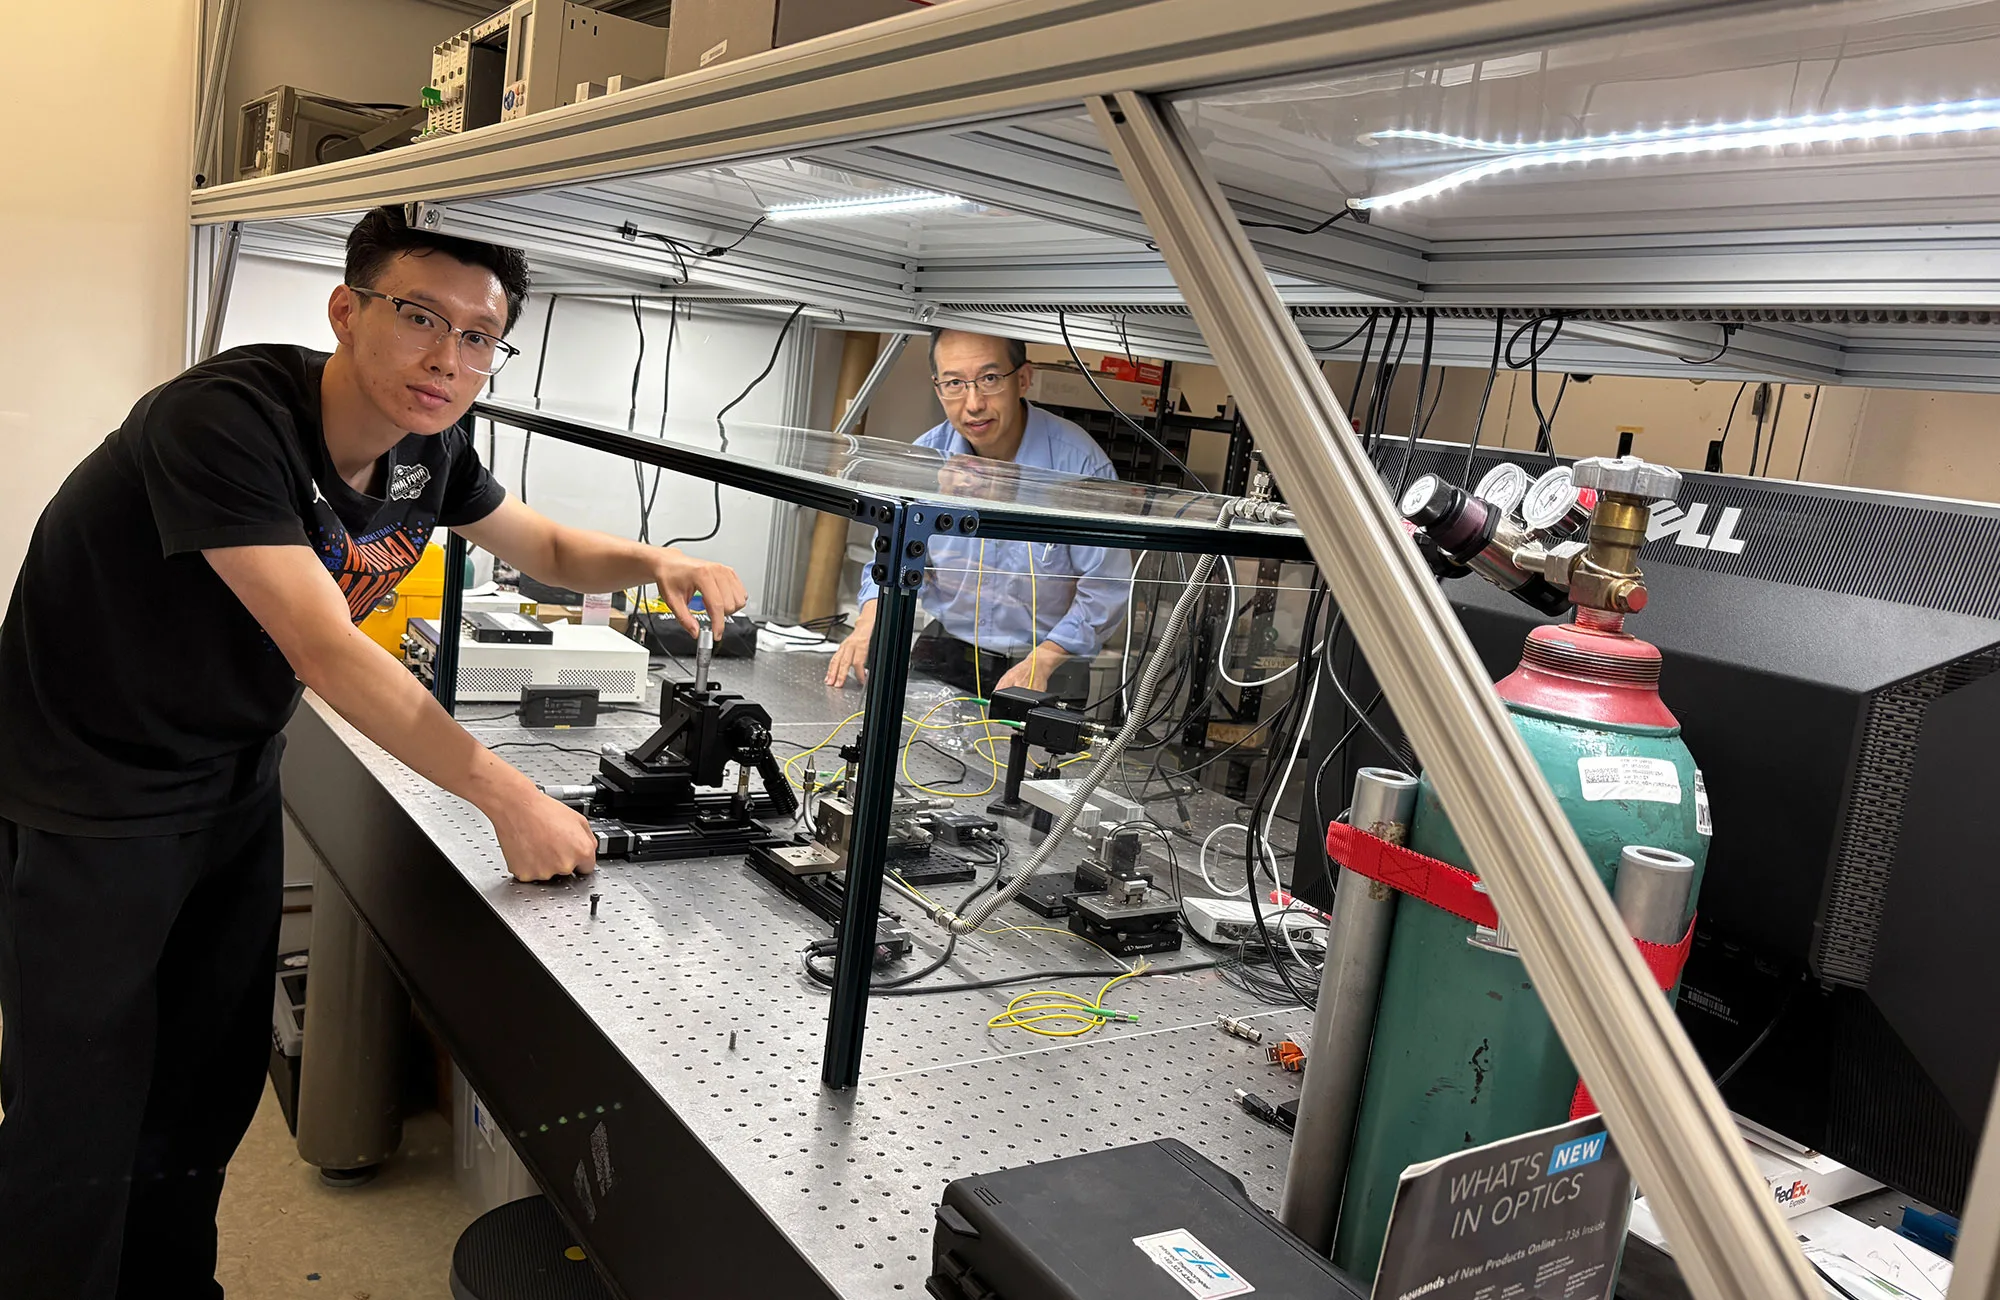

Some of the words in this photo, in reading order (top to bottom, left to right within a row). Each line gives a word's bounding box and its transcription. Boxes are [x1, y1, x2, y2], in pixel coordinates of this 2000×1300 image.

[391, 478, 409, 495] FINAL
[406, 468, 428, 487] FOUR
[1645, 500, 1746, 555] ELL
[1450, 1151, 1544, 1204] WHAT'S
[1554, 1138, 1601, 1169] NEW
[1774, 1179, 1808, 1204] FedEx
[1451, 1204, 1483, 1239] IN
[1491, 1172, 1585, 1226] OPTICS
[1446, 1268, 1460, 1285] of
[1459, 1264, 1484, 1280] New
[1484, 1248, 1526, 1272] Products
[1527, 1238, 1557, 1256] Online
[1581, 1219, 1606, 1236] Inside
